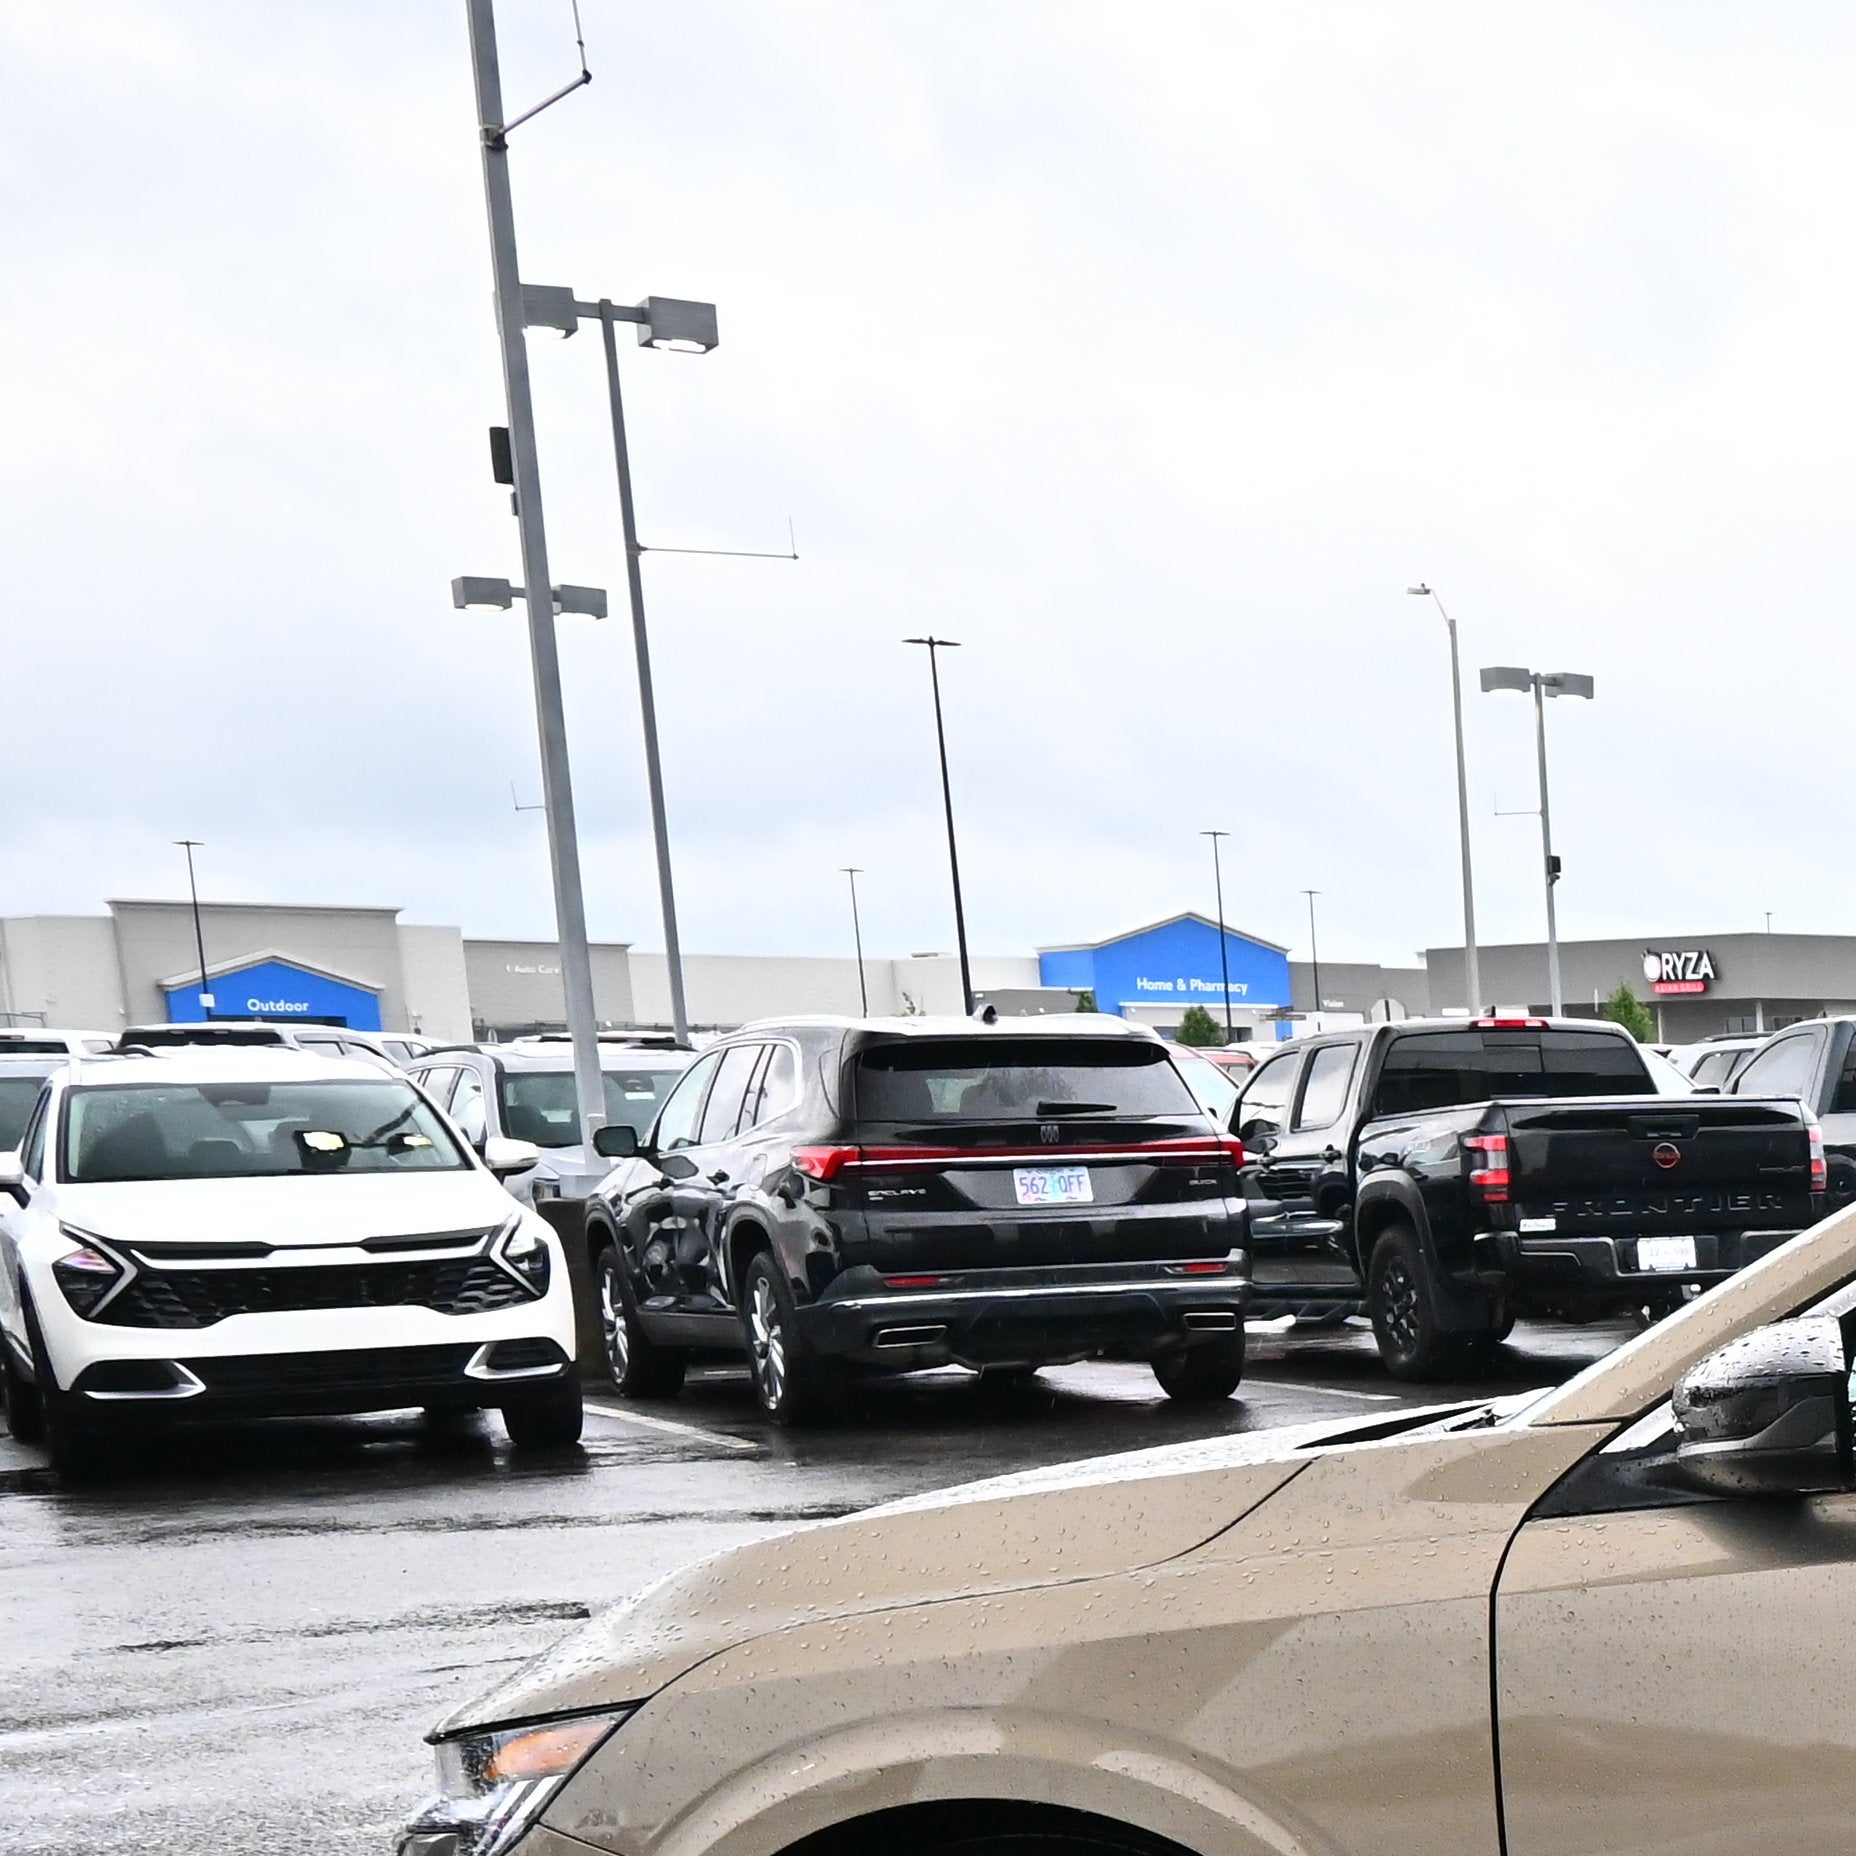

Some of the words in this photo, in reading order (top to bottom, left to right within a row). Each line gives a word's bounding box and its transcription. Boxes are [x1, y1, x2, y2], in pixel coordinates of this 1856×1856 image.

[1136, 977, 1173, 991] Home
[1177, 978, 1187, 991] &
[247, 998, 309, 1012] Outdoor
[1020, 1176, 1049, 1195] 562
